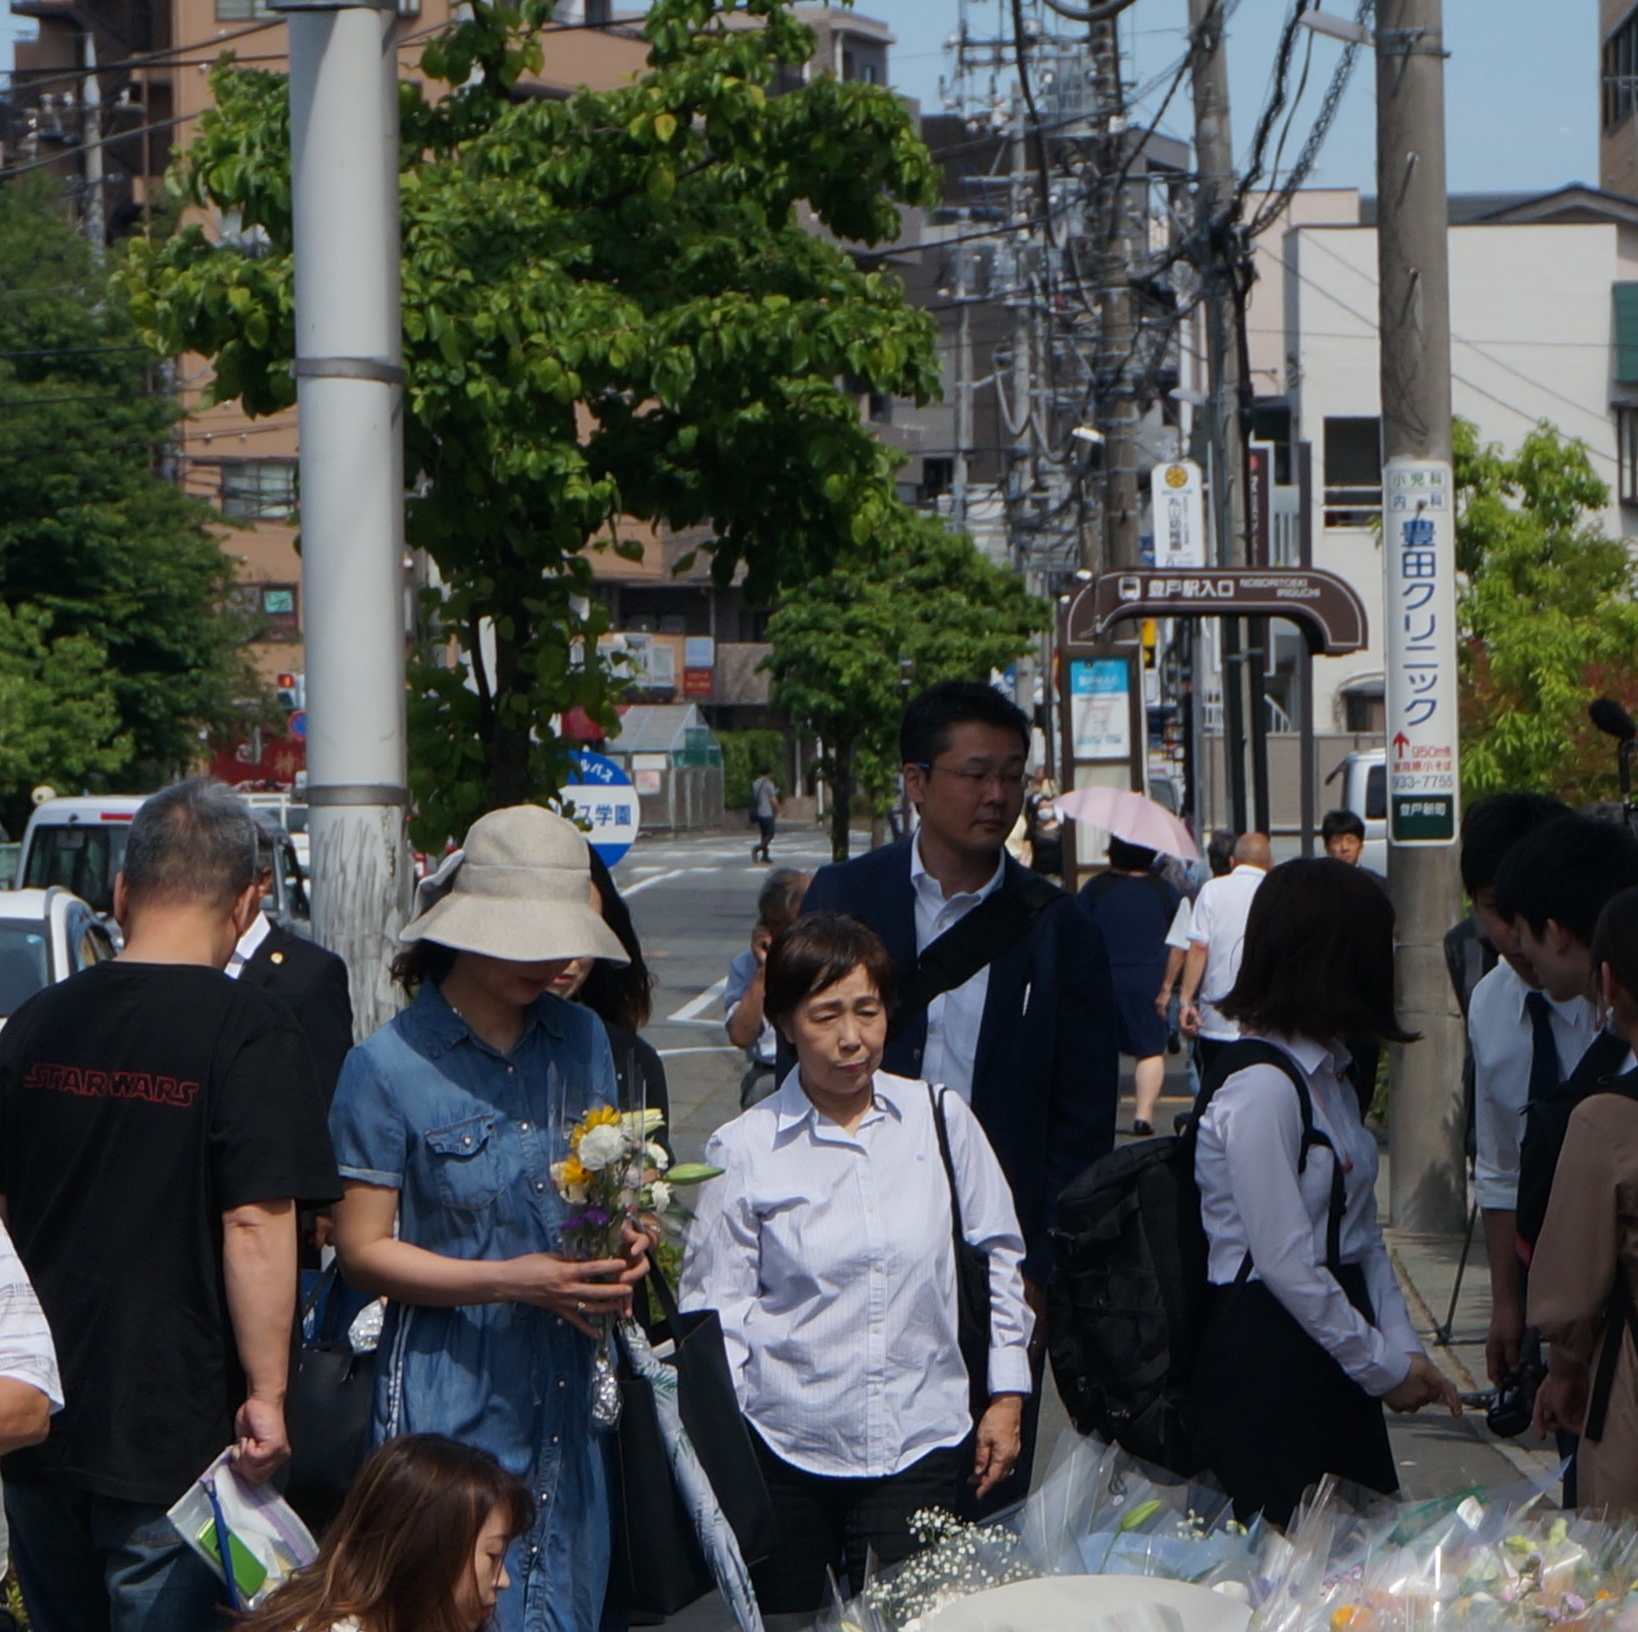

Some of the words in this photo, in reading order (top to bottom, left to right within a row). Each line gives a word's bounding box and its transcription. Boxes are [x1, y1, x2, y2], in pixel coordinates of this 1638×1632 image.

[1148, 579, 1235, 598] 登戸駅入口
[1401, 518, 1439, 727] 豊田クリニック
[578, 803, 632, 826] ス学園
[23, 1063, 108, 1097] STAR
[111, 1071, 200, 1107] WARS
